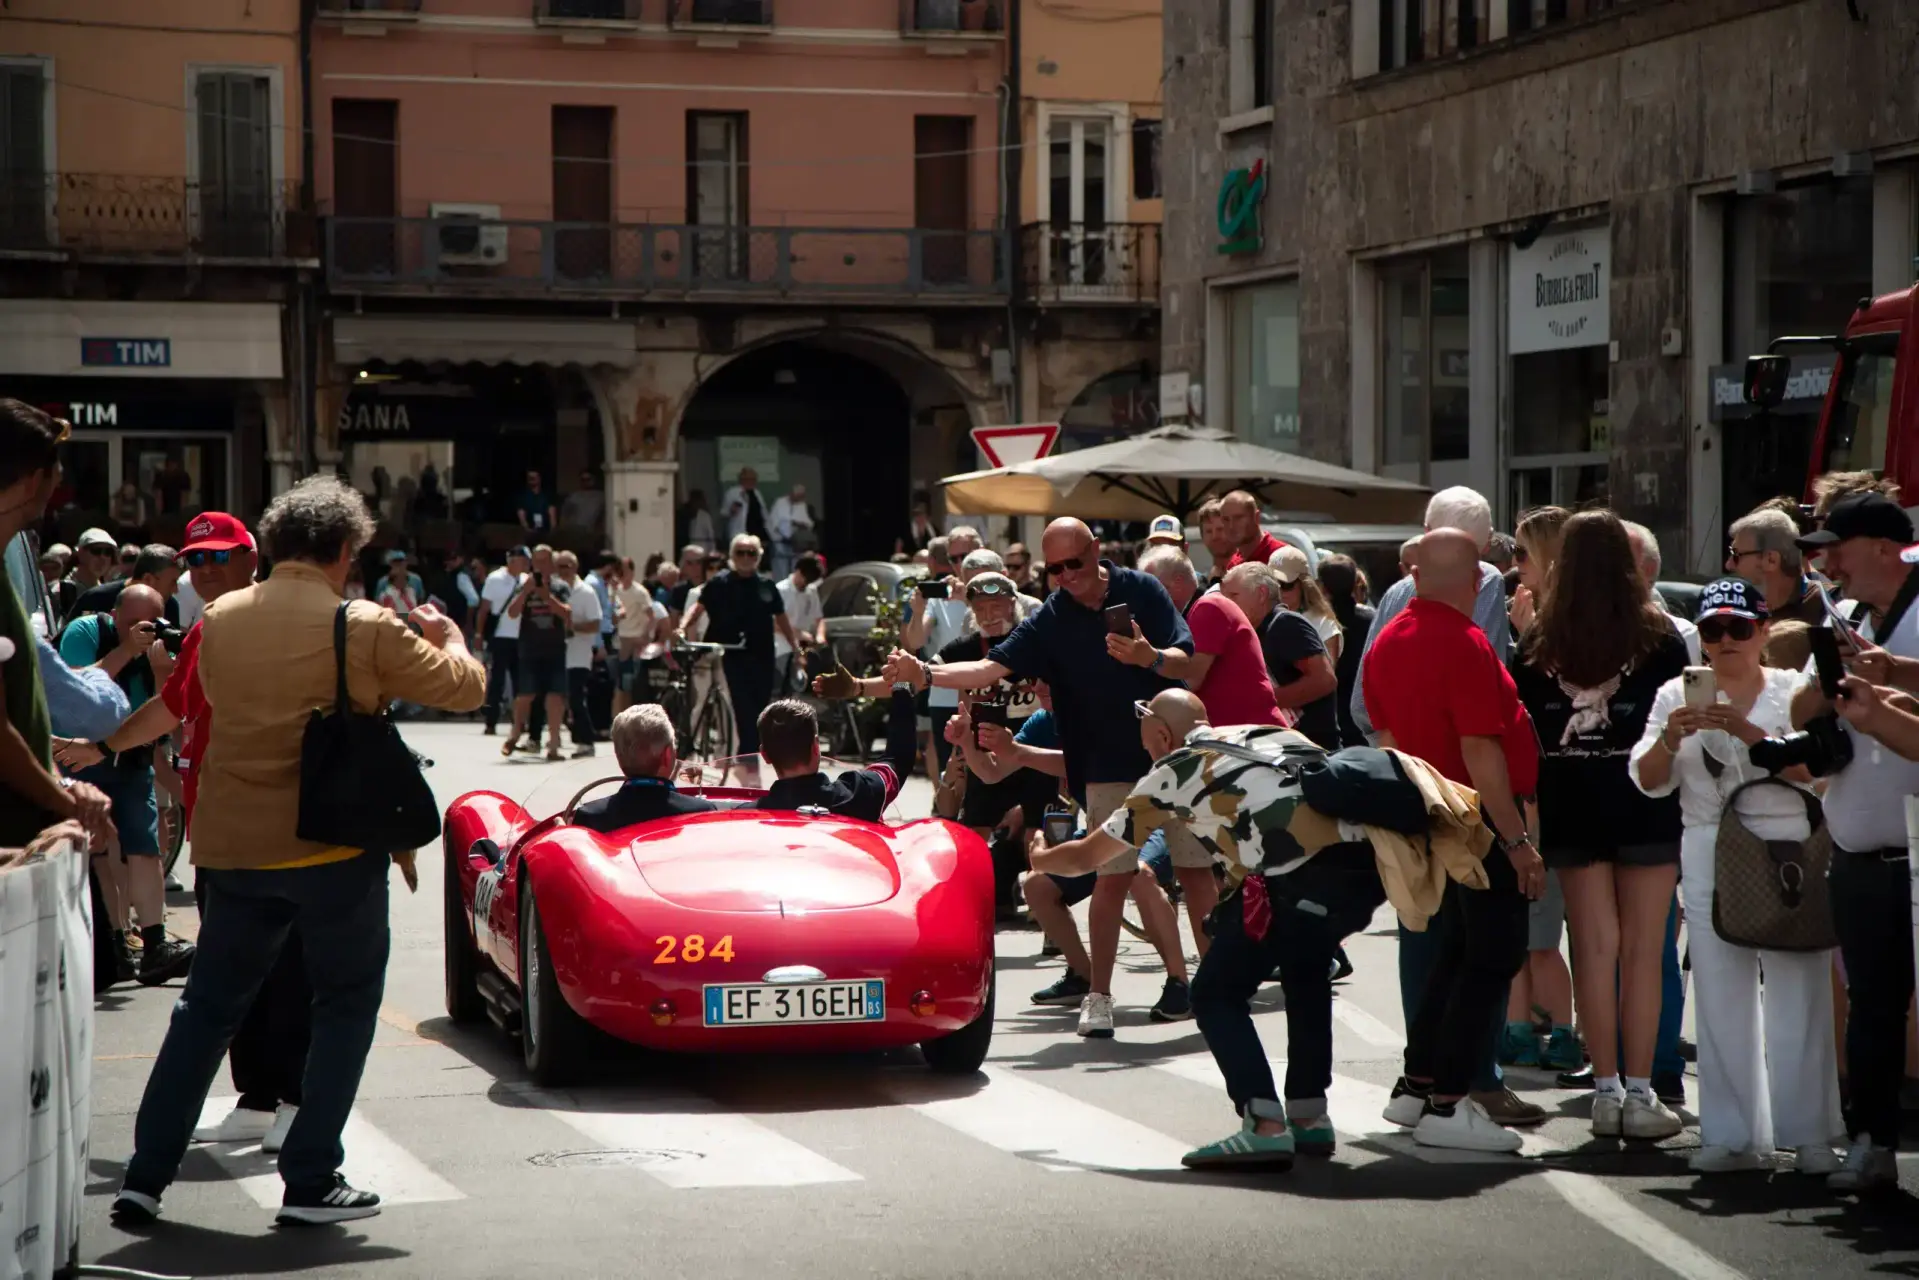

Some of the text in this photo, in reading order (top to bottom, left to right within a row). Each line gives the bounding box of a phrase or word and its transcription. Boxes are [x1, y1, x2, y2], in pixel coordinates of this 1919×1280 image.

[117, 342, 165, 363] TIM
[69, 402, 117, 425] TIM
[1703, 581, 1745, 597] 1000
[1700, 592, 1747, 614] MIGLIA
[653, 934, 736, 965] 284
[728, 990, 761, 1019] EF
[774, 986, 864, 1018] 316EH
[868, 1002, 881, 1015] BS
